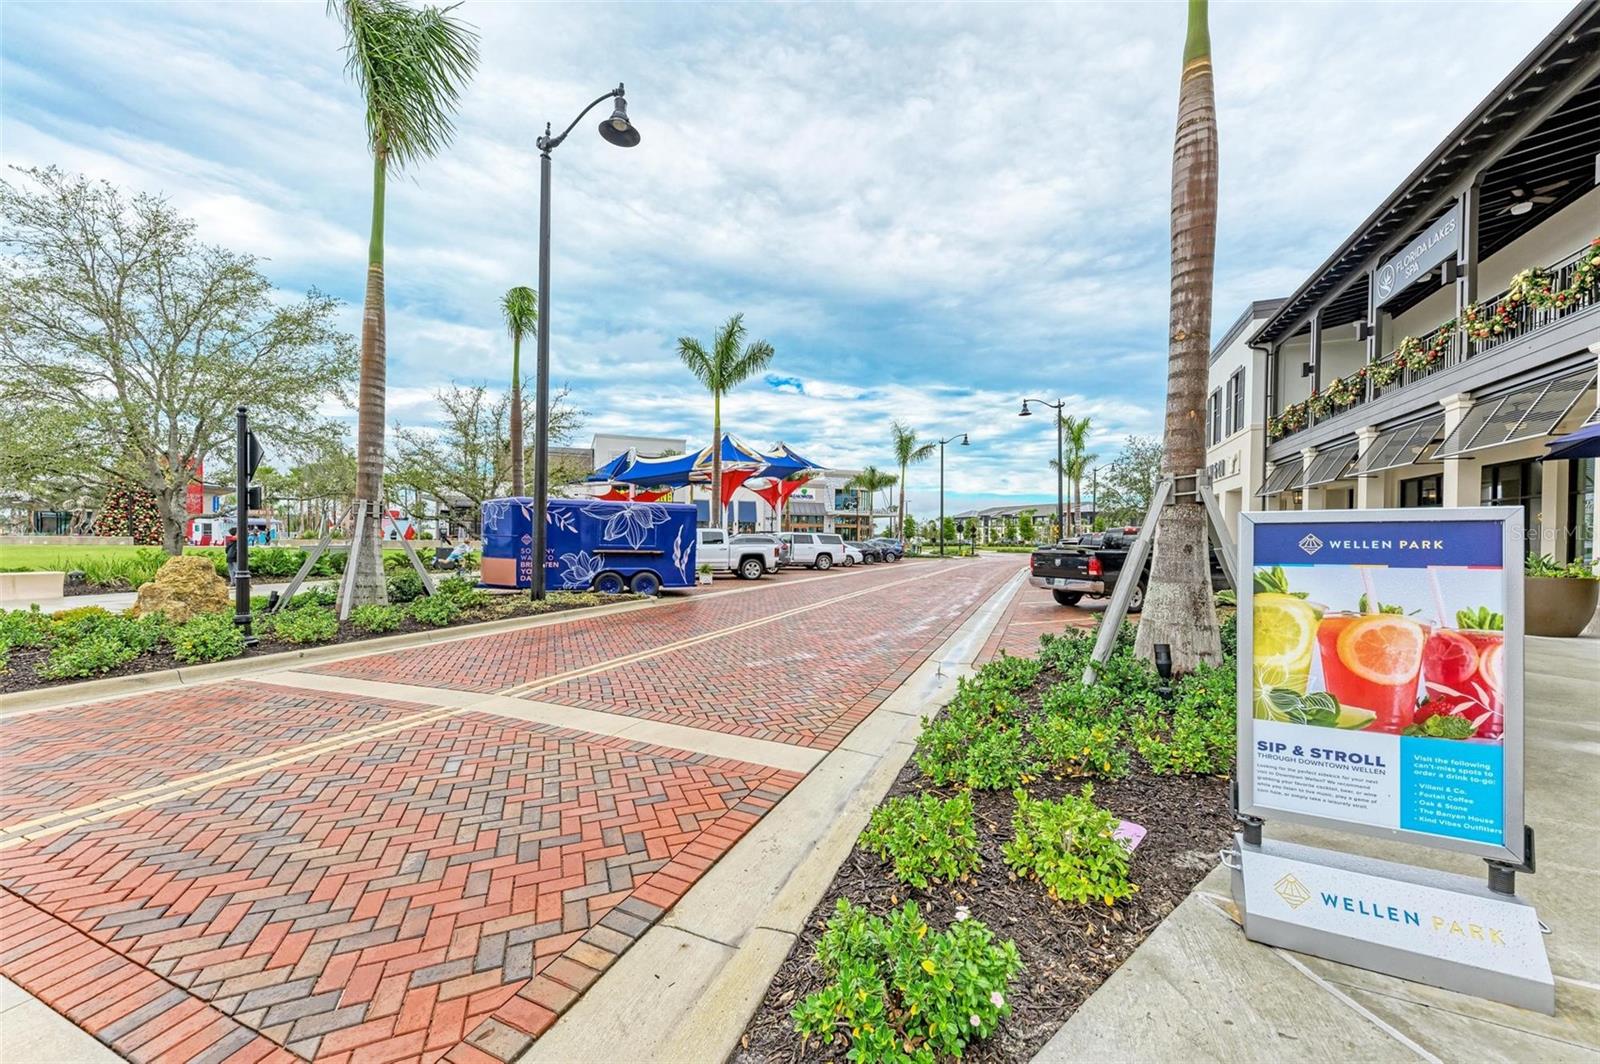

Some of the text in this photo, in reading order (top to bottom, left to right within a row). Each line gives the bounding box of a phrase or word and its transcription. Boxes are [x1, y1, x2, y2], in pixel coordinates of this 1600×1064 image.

[1396, 219, 1457, 273] FLORIDA LAKES
[1405, 262, 1419, 279] SPA
[1329, 540, 1444, 550] WELLEN PARK
[1257, 740, 1386, 767] SIP & STROLL
[1257, 752, 1386, 776] THROUGH DOWNTOWN WELLEN
[1451, 759, 1491, 770] following
[1458, 768, 1482, 776] spots
[1414, 769, 1436, 777] order
[1446, 773, 1468, 782] drink
[1470, 776, 1496, 785] to-go:
[1445, 803, 1468, 811] Stone
[1447, 795, 1474, 804] Coffee
[1419, 807, 1494, 824] The Banyan House
[1439, 820, 1461, 828] Vibes
[1463, 823, 1503, 834] Outfitters
[1320, 892, 1506, 945] WELLEN PARK
